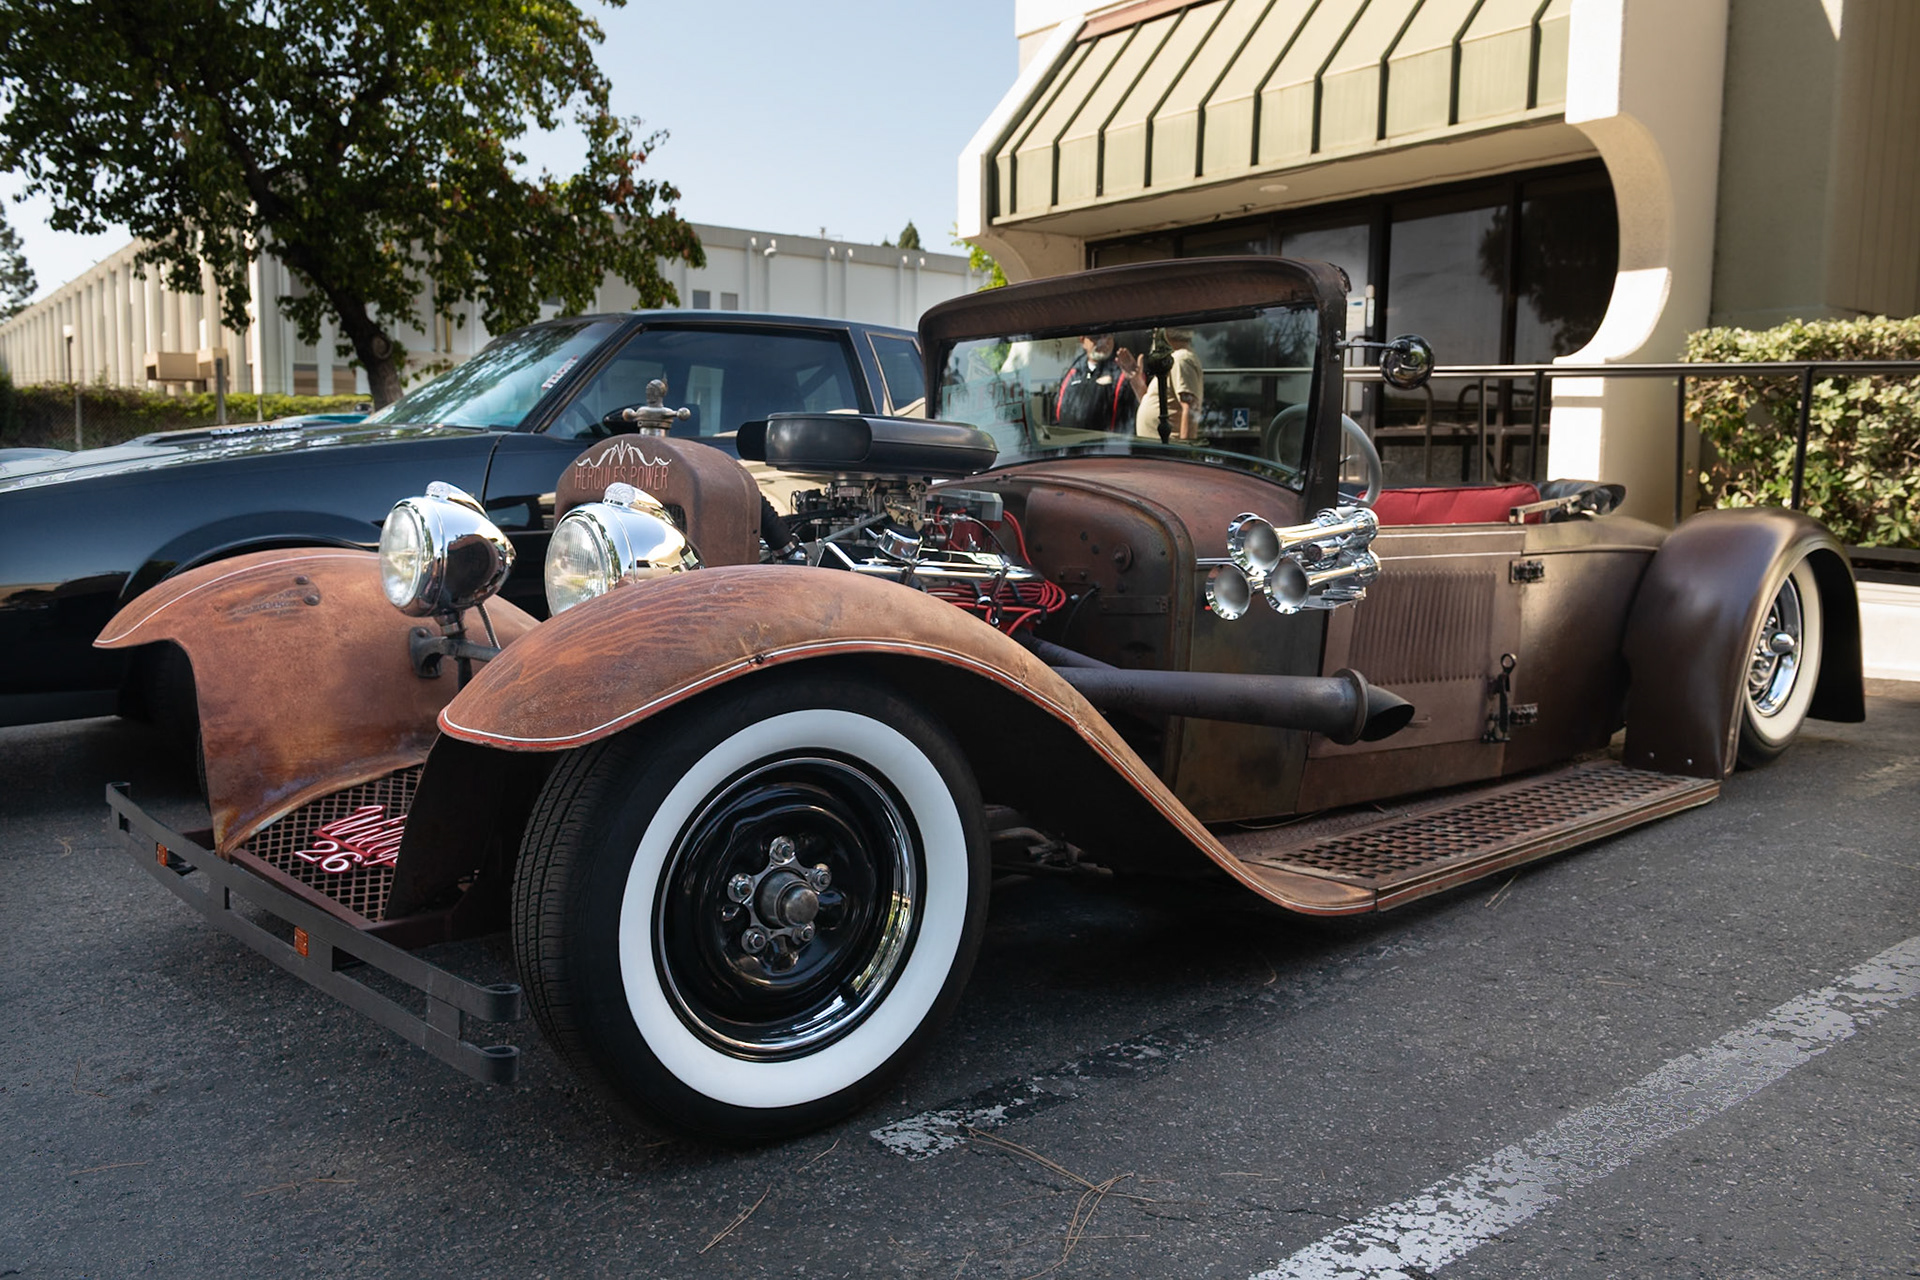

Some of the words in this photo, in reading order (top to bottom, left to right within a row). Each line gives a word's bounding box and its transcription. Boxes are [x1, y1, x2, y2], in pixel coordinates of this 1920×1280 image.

[575, 466, 626, 490] HERCULES
[630, 465, 669, 490] POWER
[320, 804, 408, 867] Willy
[293, 840, 363, 873] 26
